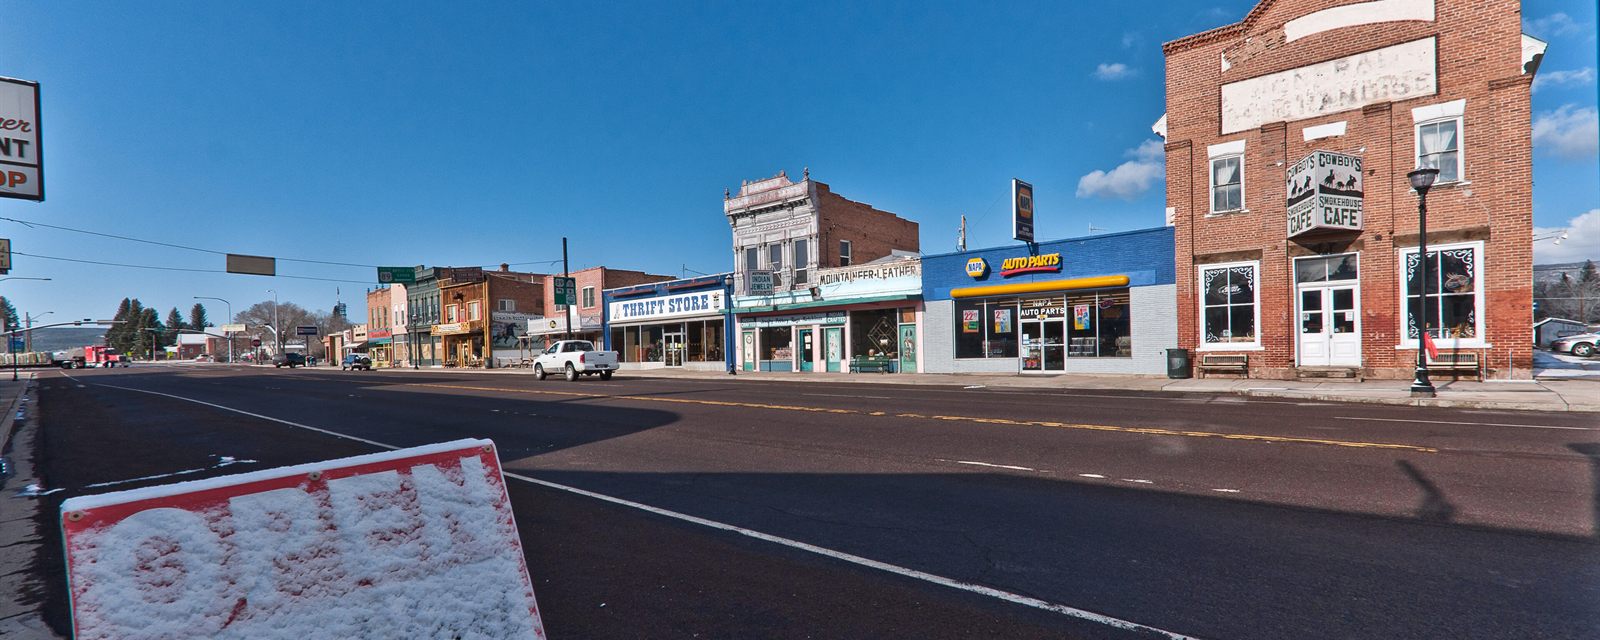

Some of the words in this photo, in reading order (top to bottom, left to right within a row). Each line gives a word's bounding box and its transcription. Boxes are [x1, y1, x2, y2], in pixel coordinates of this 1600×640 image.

[1319, 196, 1363, 212] SMOKEHOUSE
[1290, 210, 1312, 234] CAFE
[1323, 206, 1358, 226] CAFE
[1001, 257, 1028, 271] AUTO
[1028, 252, 1060, 269] PARTS
[751, 283, 773, 291] JEWELRY
[623, 300, 665, 317] THRIFT
[668, 294, 709, 313] STORE
[1020, 309, 1039, 317] AUTO
[1040, 307, 1065, 316] PARTS
